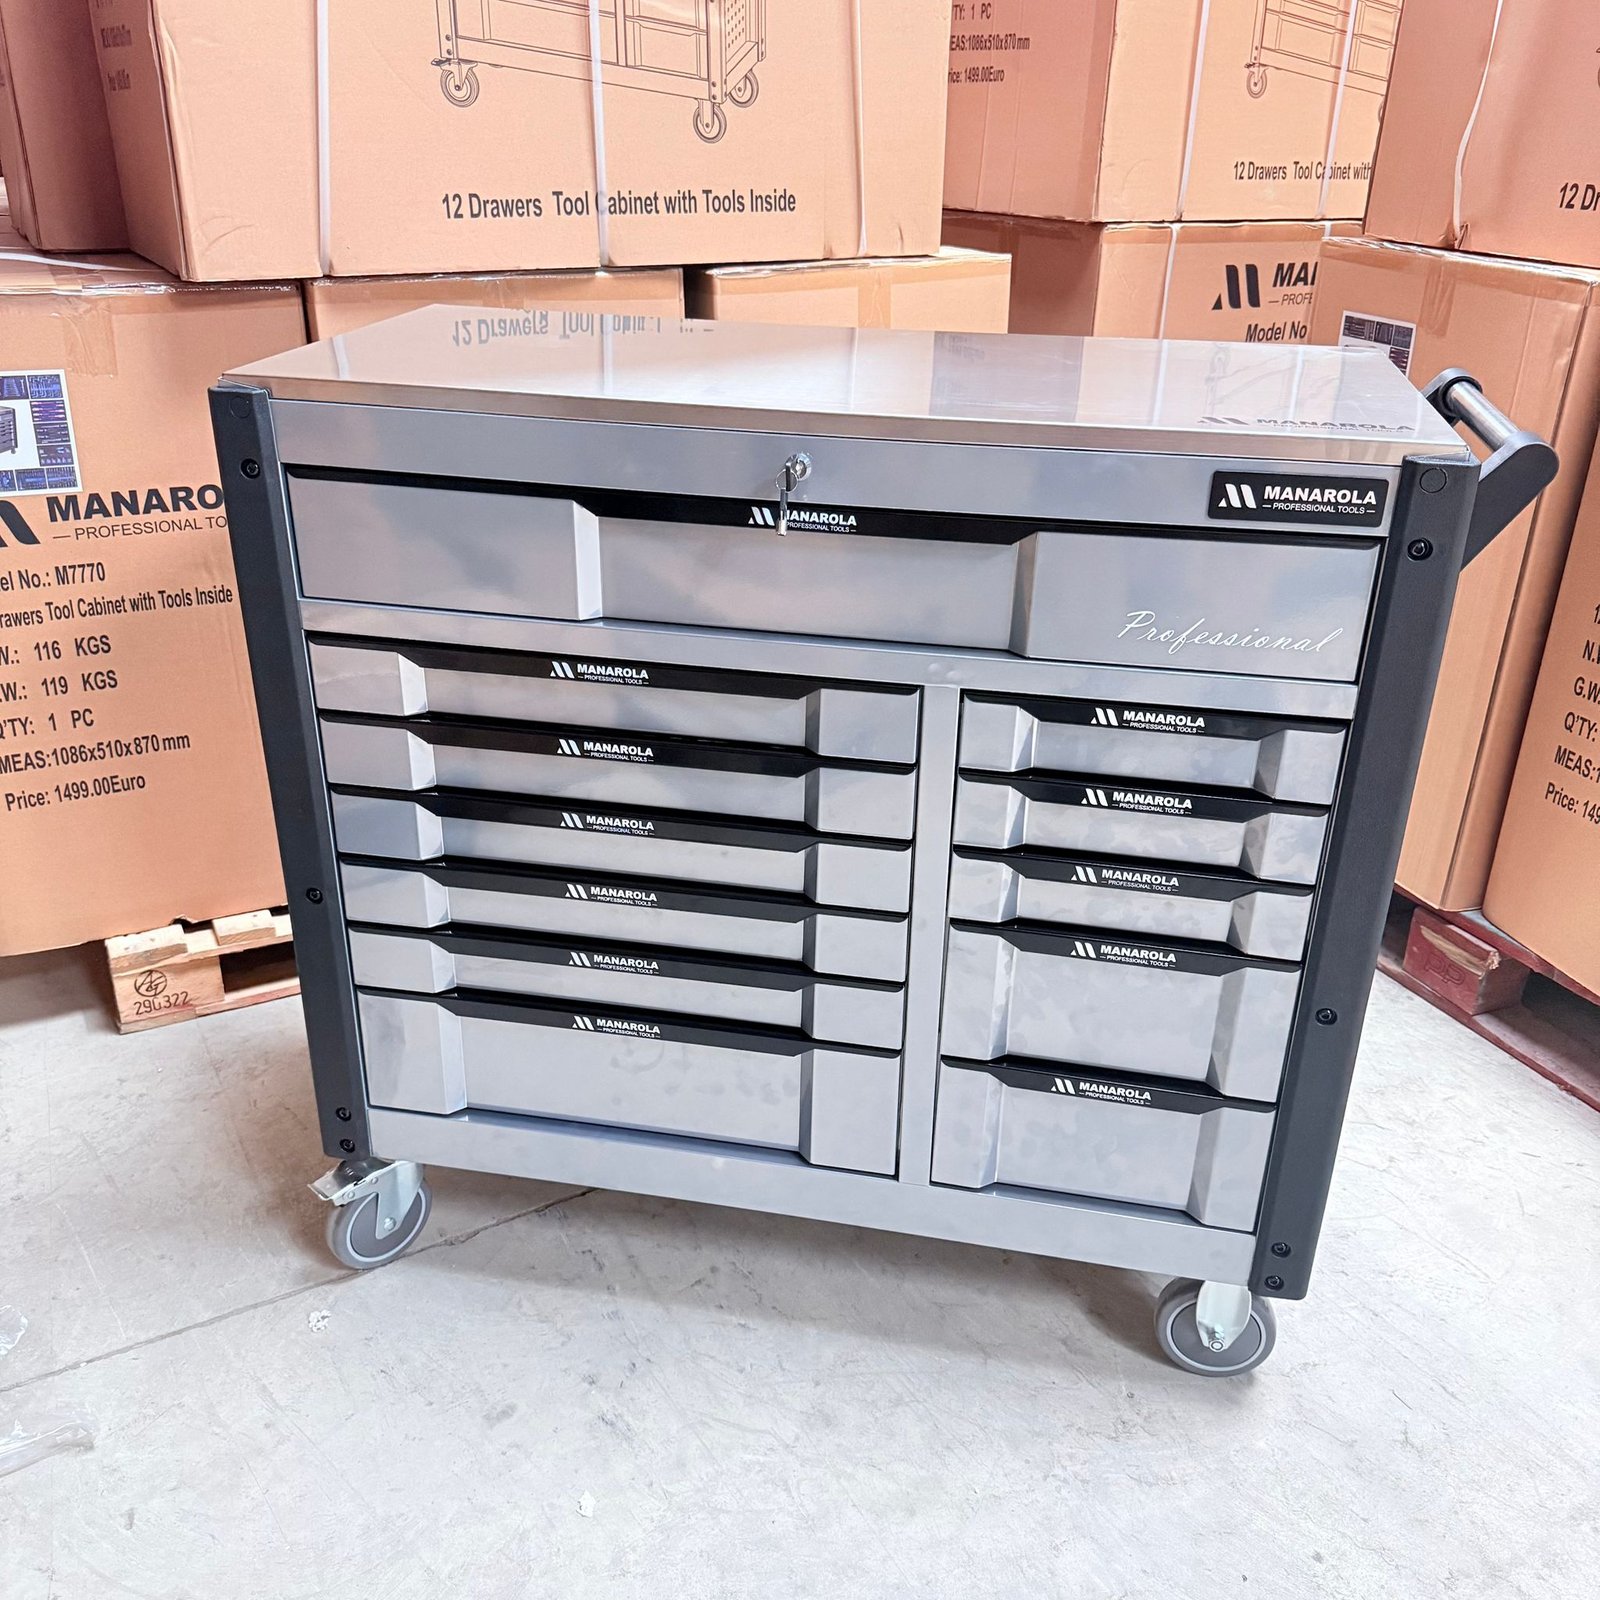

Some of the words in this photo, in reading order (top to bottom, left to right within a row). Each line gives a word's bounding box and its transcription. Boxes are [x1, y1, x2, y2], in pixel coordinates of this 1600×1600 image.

[971, 4, 975, 20] 1
[981, 3, 992, 19] PC
[964, 66, 1005, 83] 1499.00Euro
[1234, 161, 1245, 180] 12
[1247, 161, 1287, 180] Drawers
[1293, 161, 1314, 180] Tool
[442, 193, 464, 219] 12
[468, 193, 543, 218] Drawers
[552, 190, 590, 216] Tool
[664, 189, 697, 213] with
[702, 188, 745, 213] Tools
[750, 188, 796, 212] Inside
[1559, 182, 1579, 209] 12
[1245, 321, 1287, 343] Model
[1263, 485, 1377, 505] MANAROLA
[1272, 502, 1336, 513] PROFESSIONAL
[1337, 505, 1365, 515] TOOLS
[75, 517, 203, 541] PROFESSIONAL
[830, 525, 850, 533] TOOLS
[17, 568, 51, 590] No.:
[54, 561, 106, 586] M7770
[45, 599, 75, 621] Tool
[77, 595, 127, 618] Cabinet
[129, 591, 156, 612] with
[158, 588, 193, 609] Tools
[195, 584, 233, 606] Inside
[1118, 610, 1344, 655] Professional
[34, 640, 62, 661] 116
[74, 635, 111, 656] KGS
[577, 663, 649, 680] MANAROLA
[41, 676, 68, 697] 119
[81, 669, 118, 692] KGS
[48, 712, 57, 731] 1
[70, 708, 94, 729] PC
[1123, 710, 1205, 727] MANAROLA
[1564, 711, 1598, 742] Q'TY:
[583, 741, 653, 757] MANAROLA
[5, 790, 51, 812] Price:
[54, 775, 146, 803] 1499.00Euro
[1112, 791, 1193, 809] MANAROLA
[1545, 781, 1579, 813] Price:
[1164, 807, 1185, 815] TOOLS
[586, 815, 655, 831] MANAROLA
[1101, 869, 1179, 887] MANAROLA
[590, 886, 657, 901] MANAROLA
[593, 954, 659, 970] MANAROLA
[1100, 944, 1176, 962] MANAROLA
[1150, 960, 1169, 968] TOOLS
[596, 1018, 660, 1034] MANAROLA
[1079, 1081, 1152, 1101] MANAROLA
